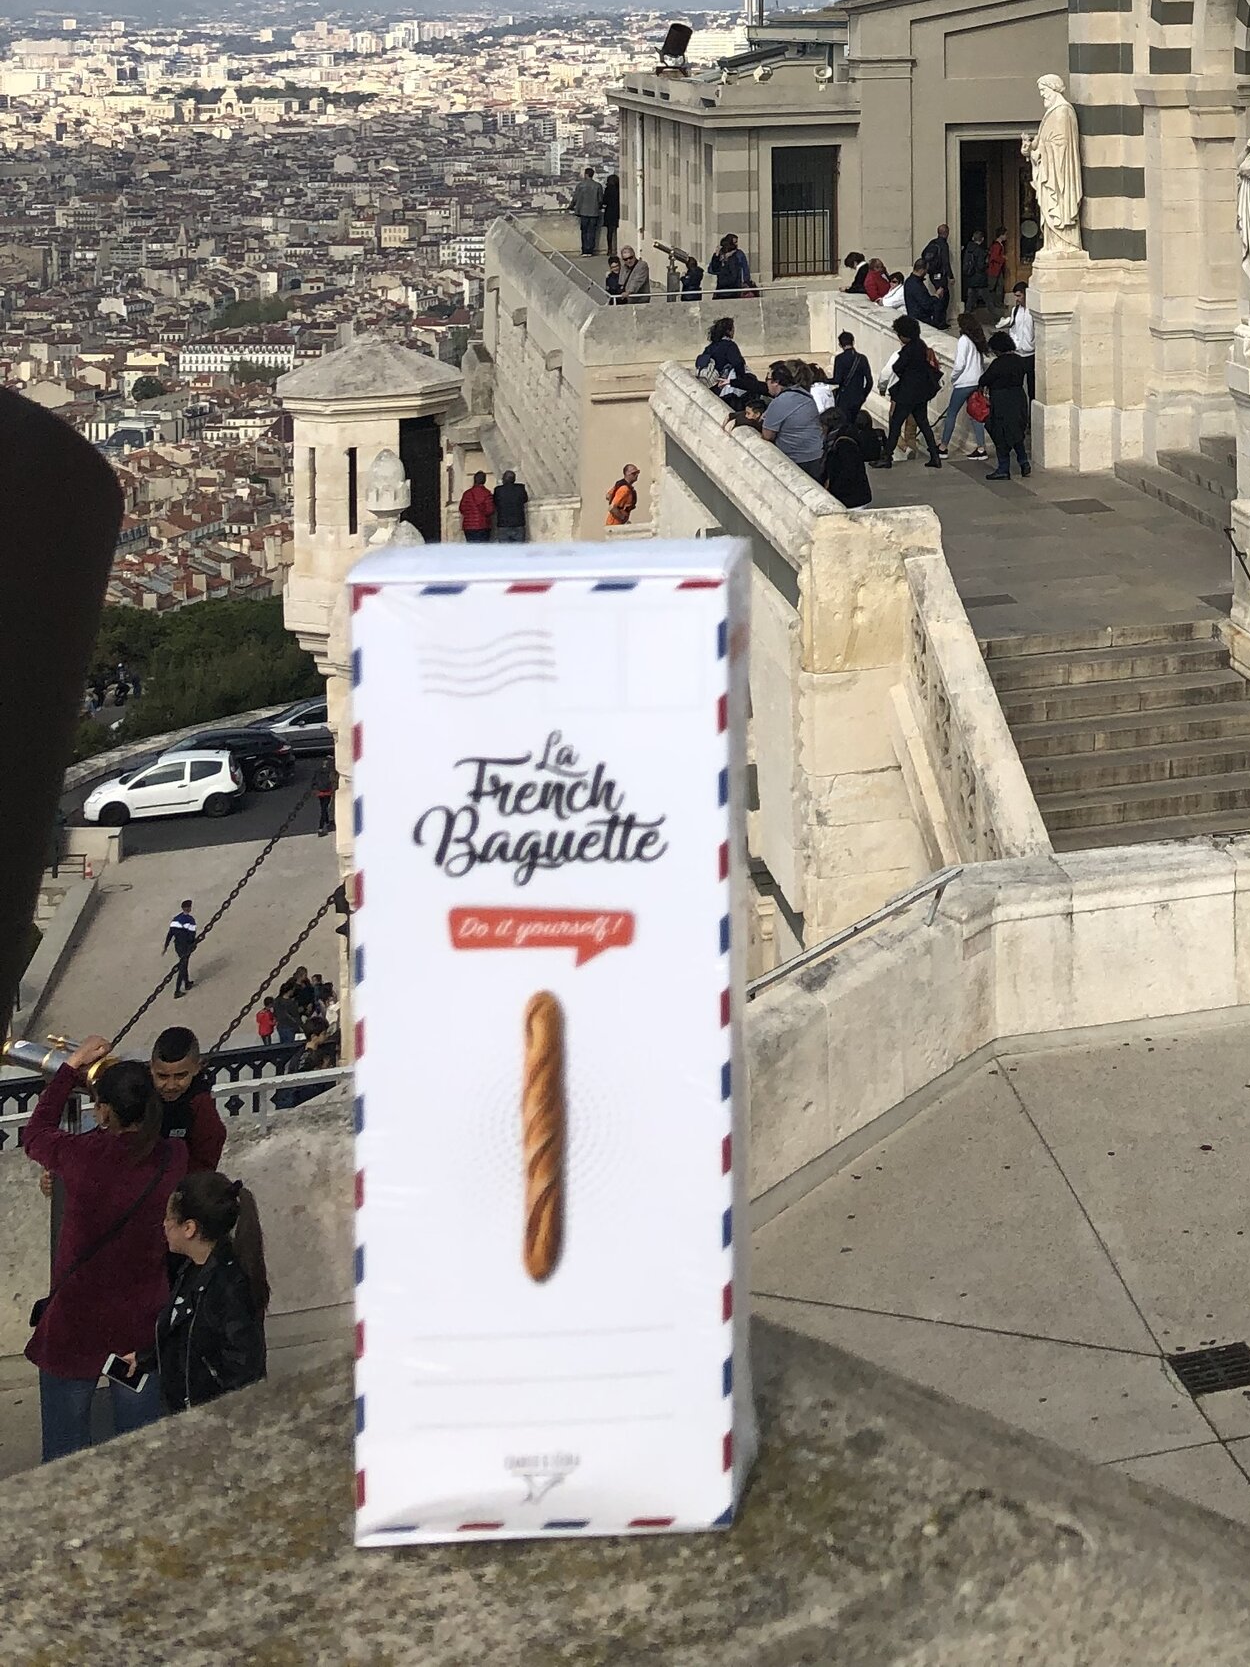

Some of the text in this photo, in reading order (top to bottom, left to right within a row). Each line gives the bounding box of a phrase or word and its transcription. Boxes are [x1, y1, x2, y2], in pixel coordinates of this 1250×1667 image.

[535, 729, 588, 777] La
[453, 750, 625, 820] French
[412, 804, 669, 887] Baguette
[459, 917, 489, 937] Do
[495, 918, 513, 935] it
